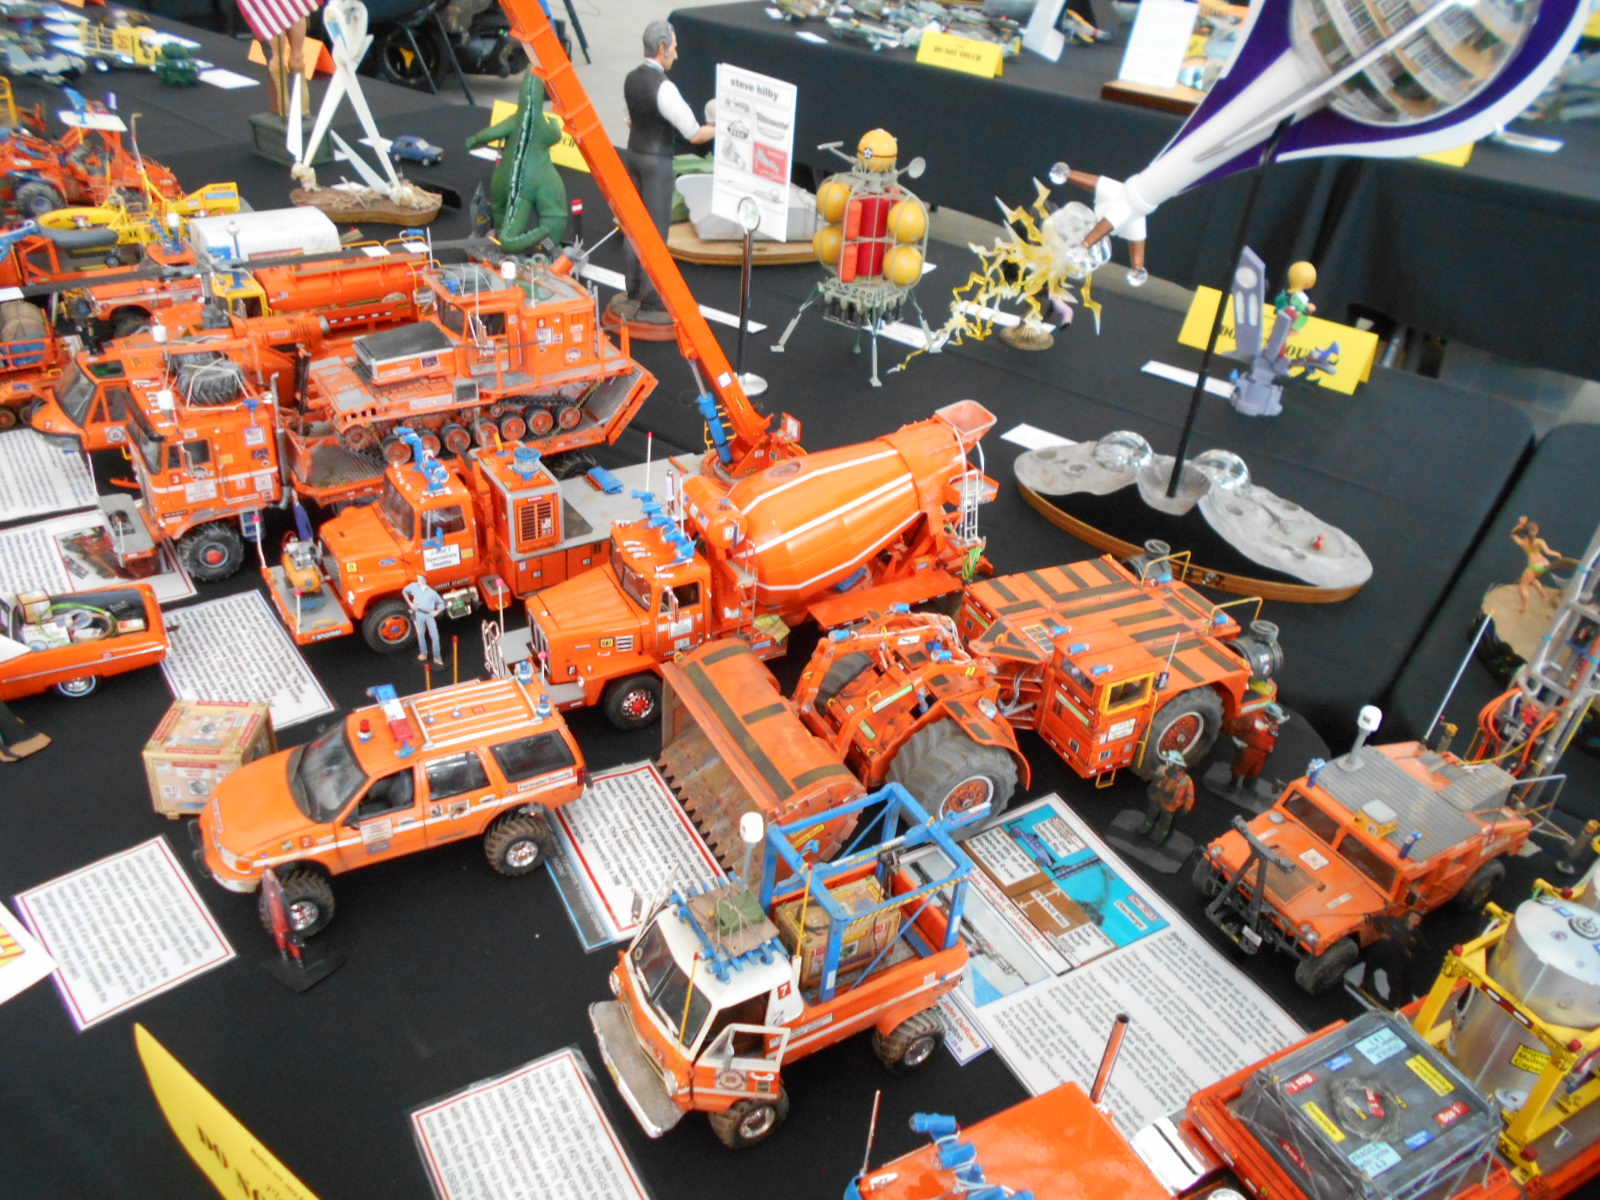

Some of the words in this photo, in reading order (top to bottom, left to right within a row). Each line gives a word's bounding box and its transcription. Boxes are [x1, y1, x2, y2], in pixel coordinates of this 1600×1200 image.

[731, 77, 754, 92] steve
[756, 84, 779, 101] hilby
[780, 985, 789, 996] 7
[1438, 1110, 1455, 1123] Box
